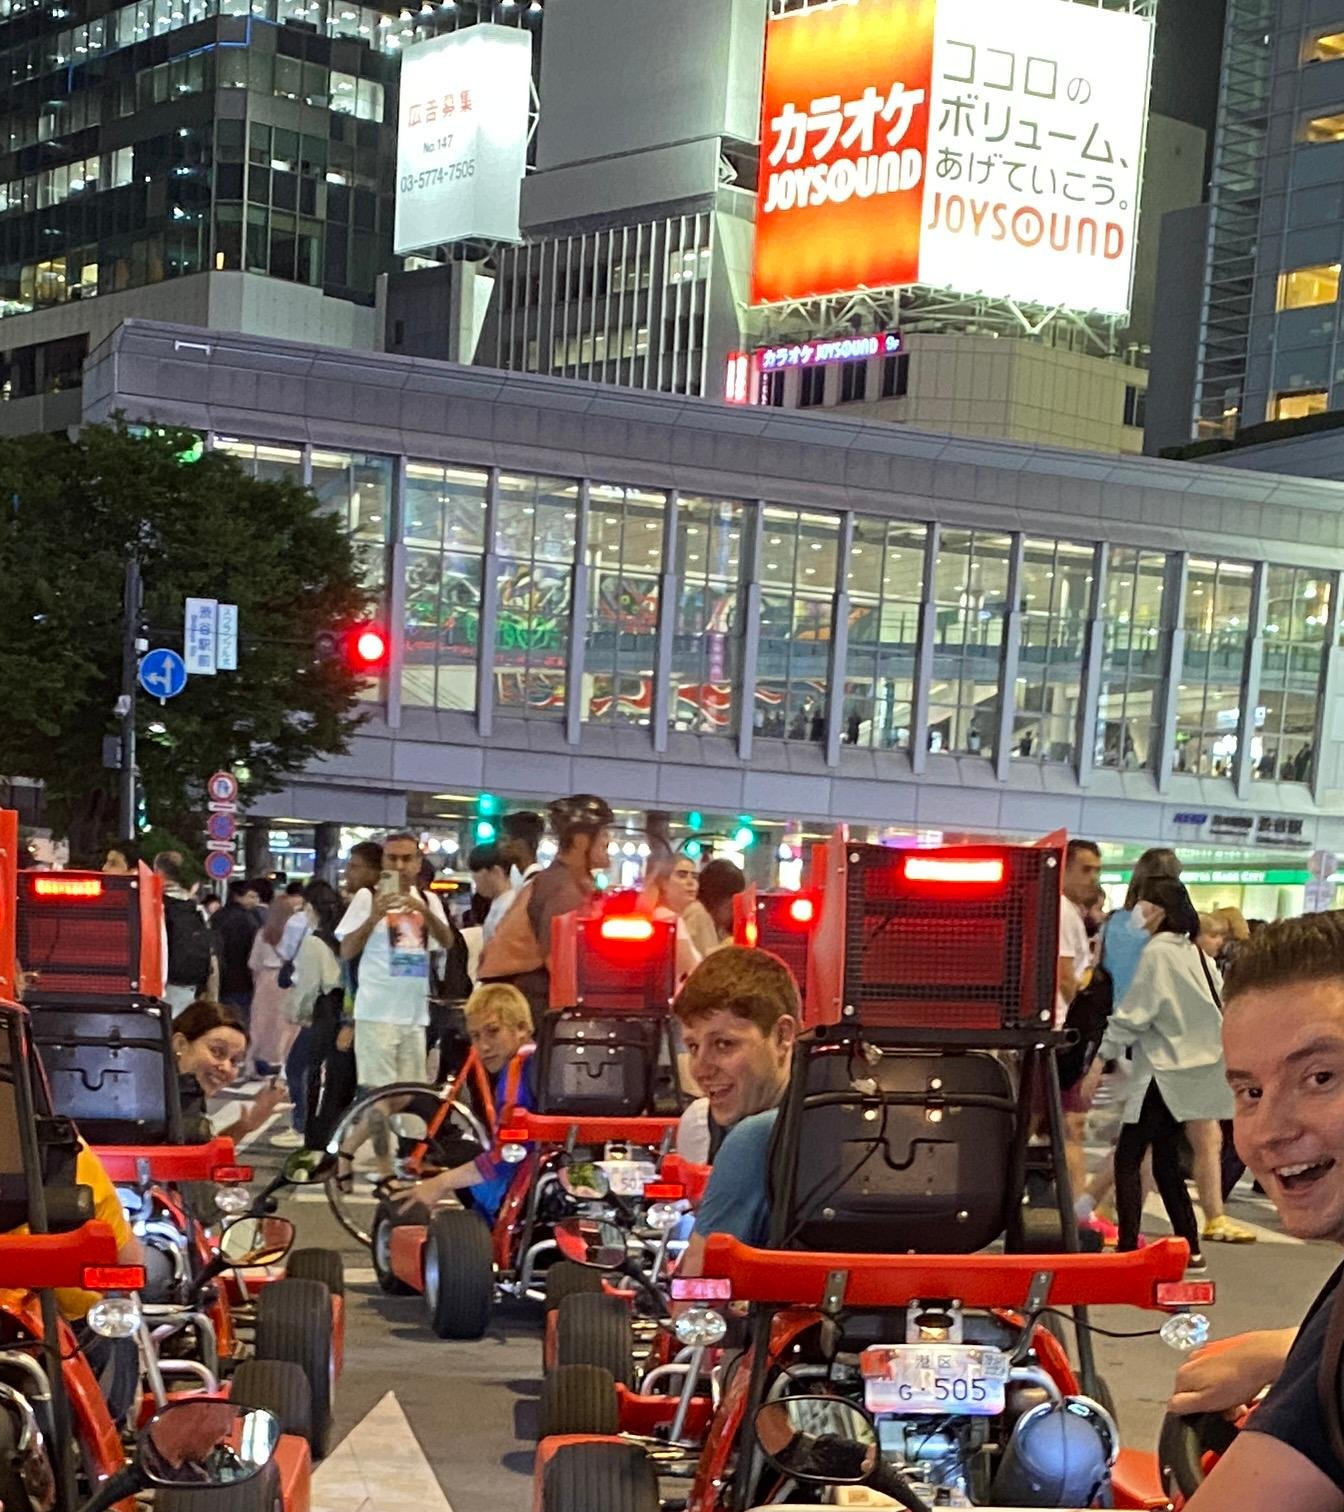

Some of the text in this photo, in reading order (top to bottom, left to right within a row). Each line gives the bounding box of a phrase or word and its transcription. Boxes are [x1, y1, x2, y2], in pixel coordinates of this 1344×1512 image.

[943, 39, 1092, 105] ココロの
[768, 81, 925, 167] カラオケ
[938, 94, 1129, 168] ボリューム、
[764, 148, 922, 213] JOYSOUND
[936, 147, 1128, 210] あげていこう。
[928, 192, 1125, 259] JOYSOUND
[763, 345, 814, 368] カラオケ
